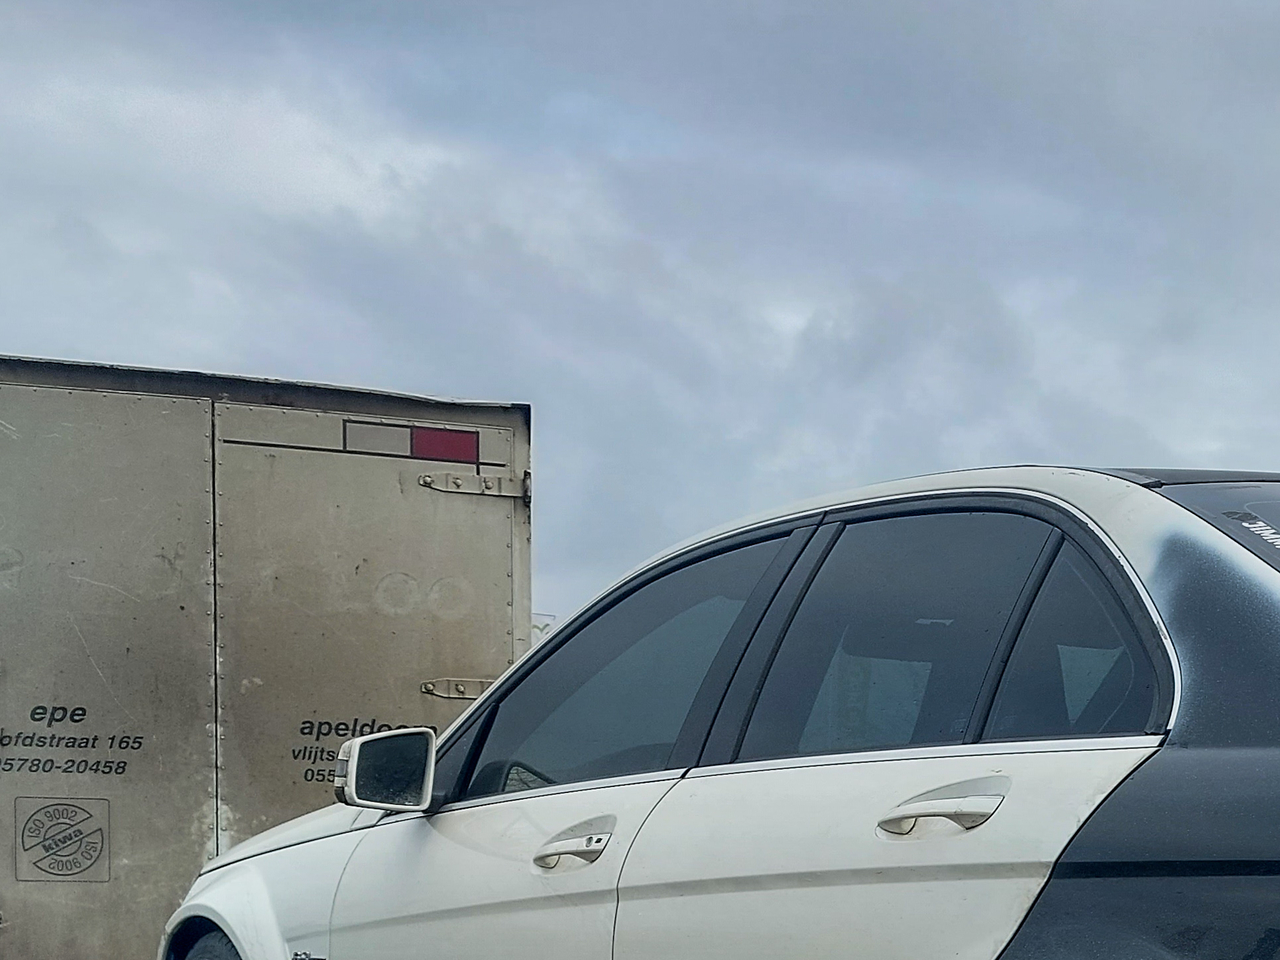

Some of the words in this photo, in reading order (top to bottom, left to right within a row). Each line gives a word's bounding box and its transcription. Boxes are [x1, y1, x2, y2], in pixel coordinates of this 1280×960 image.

[30, 704, 87, 728] epe
[108, 735, 143, 750] 165
[27, 818, 45, 838] ISO
[44, 808, 78, 822] 9002
[41, 828, 84, 854] kiwa
[81, 841, 99, 861] ISO
[48, 857, 82, 872] 9002
